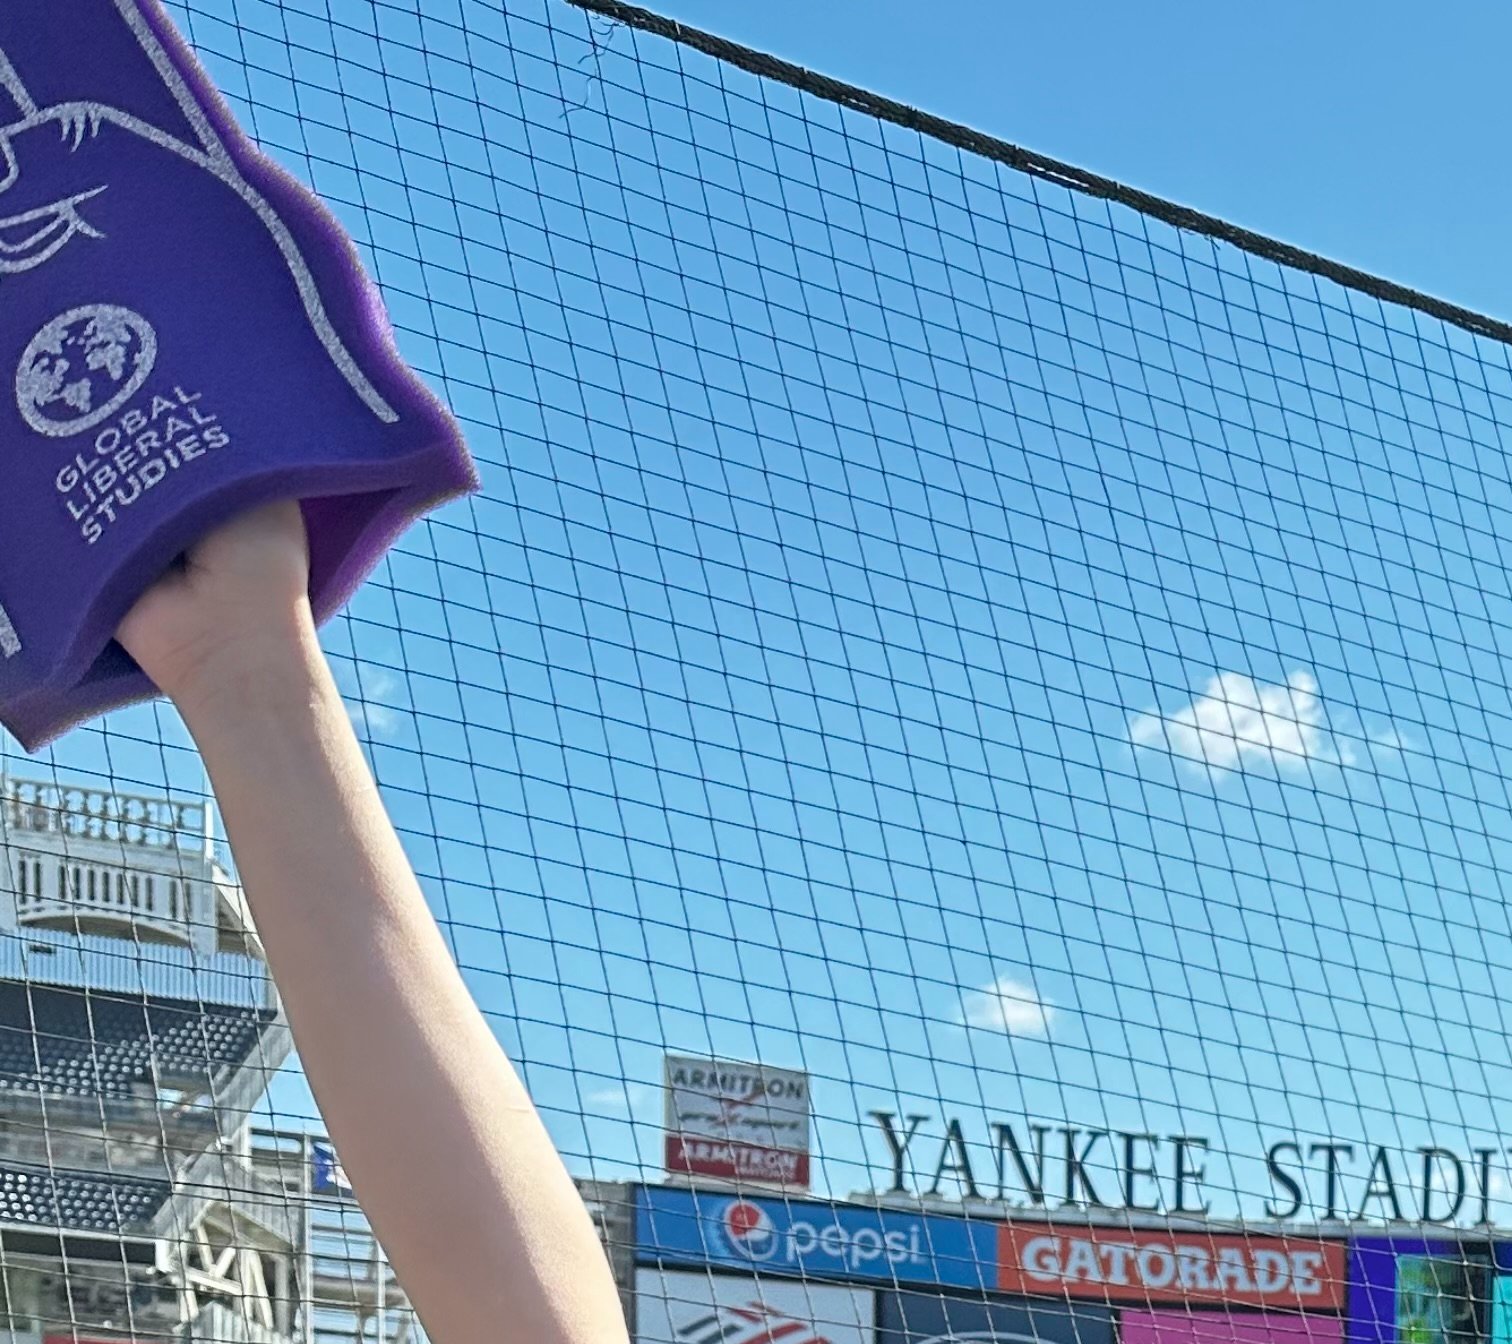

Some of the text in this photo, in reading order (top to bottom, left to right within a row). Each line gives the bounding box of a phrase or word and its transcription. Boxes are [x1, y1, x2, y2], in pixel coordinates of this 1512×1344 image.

[56, 386, 202, 492] GLOBAL
[66, 406, 217, 520] LIBERAL
[82, 425, 230, 544] STUDIES
[672, 1068, 804, 1099] ARMITRON
[867, 1110, 1212, 1214] YANKEE
[785, 1219, 926, 1268] pepsi
[1021, 1236, 1324, 1296] GATORADE
